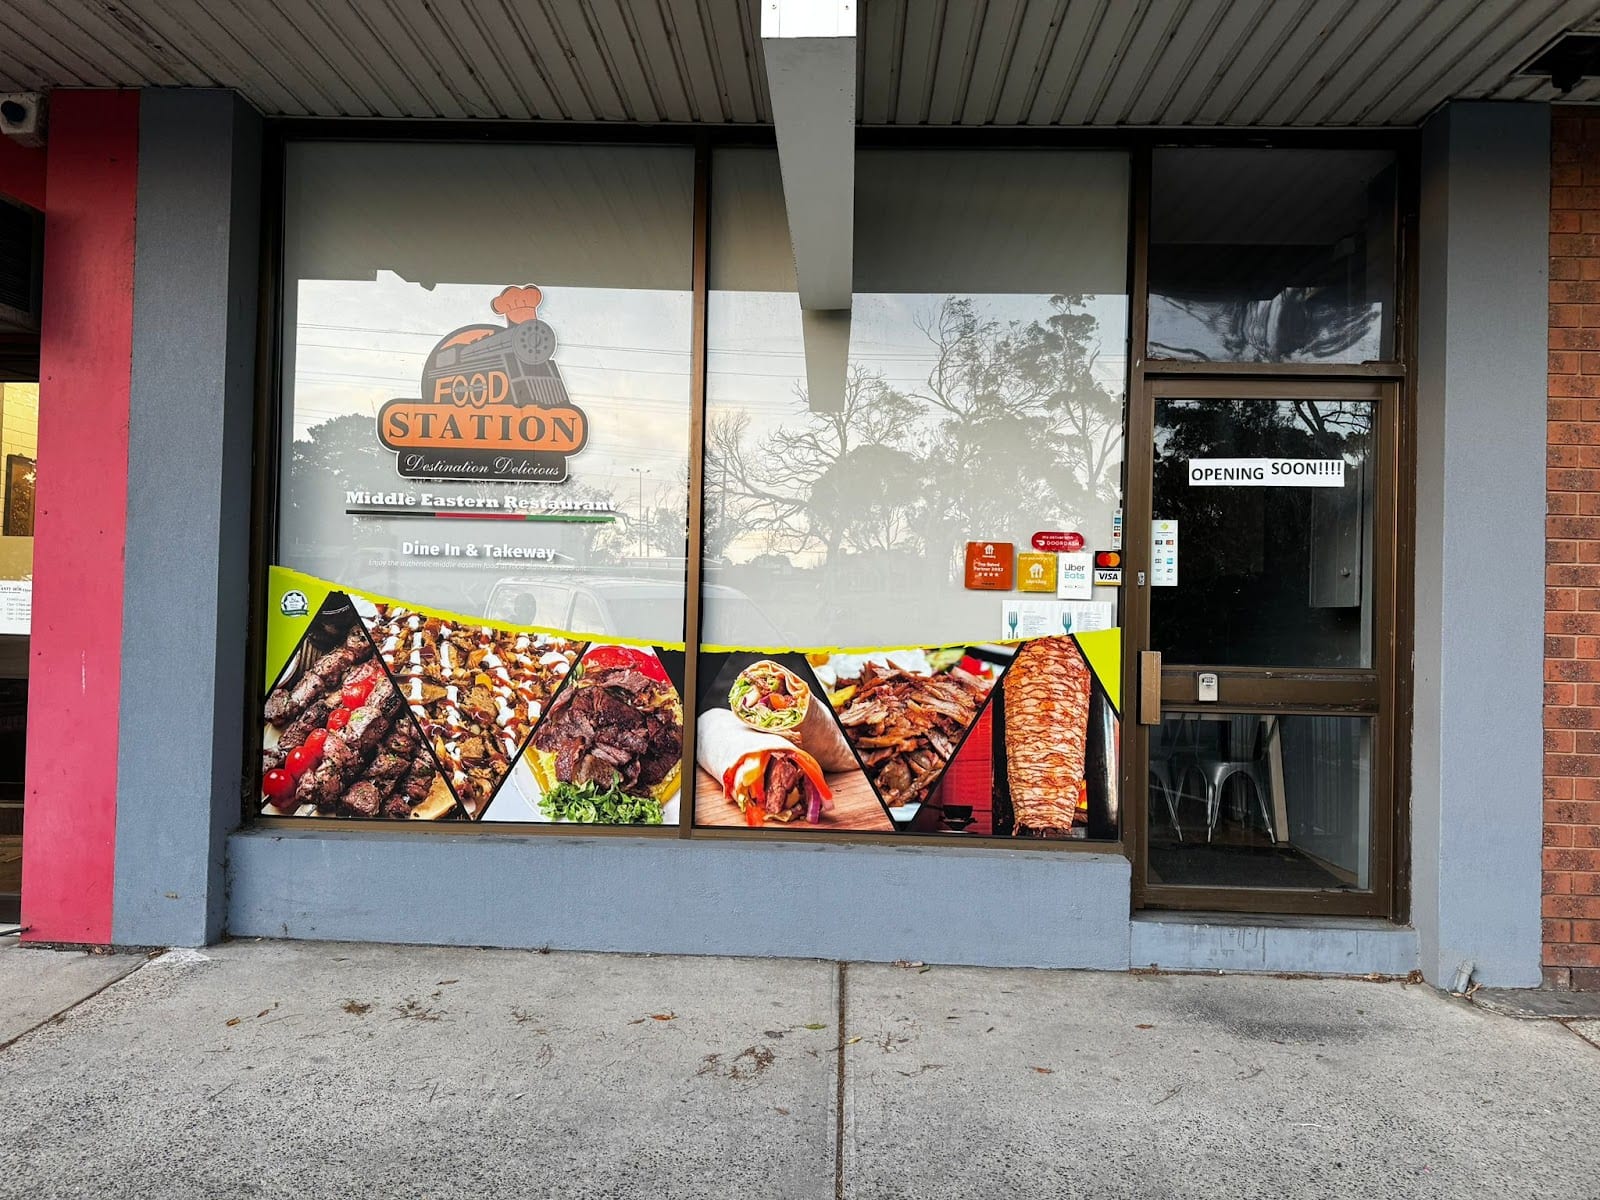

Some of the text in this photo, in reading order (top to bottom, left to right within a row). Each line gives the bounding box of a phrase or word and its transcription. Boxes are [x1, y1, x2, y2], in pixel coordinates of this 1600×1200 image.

[433, 371, 509, 407] FOOD
[389, 411, 576, 443] STATION
[405, 454, 559, 475] Destination Delicious
[1191, 462, 1342, 481] OPENING SOON!!!!
[345, 491, 616, 511] Middle Eastern Restaurant
[402, 540, 556, 561] Dine In & Takeway
[1064, 563, 1086, 572] Uber
[1064, 571, 1086, 580] Eats
[1098, 572, 1119, 580] VISA
